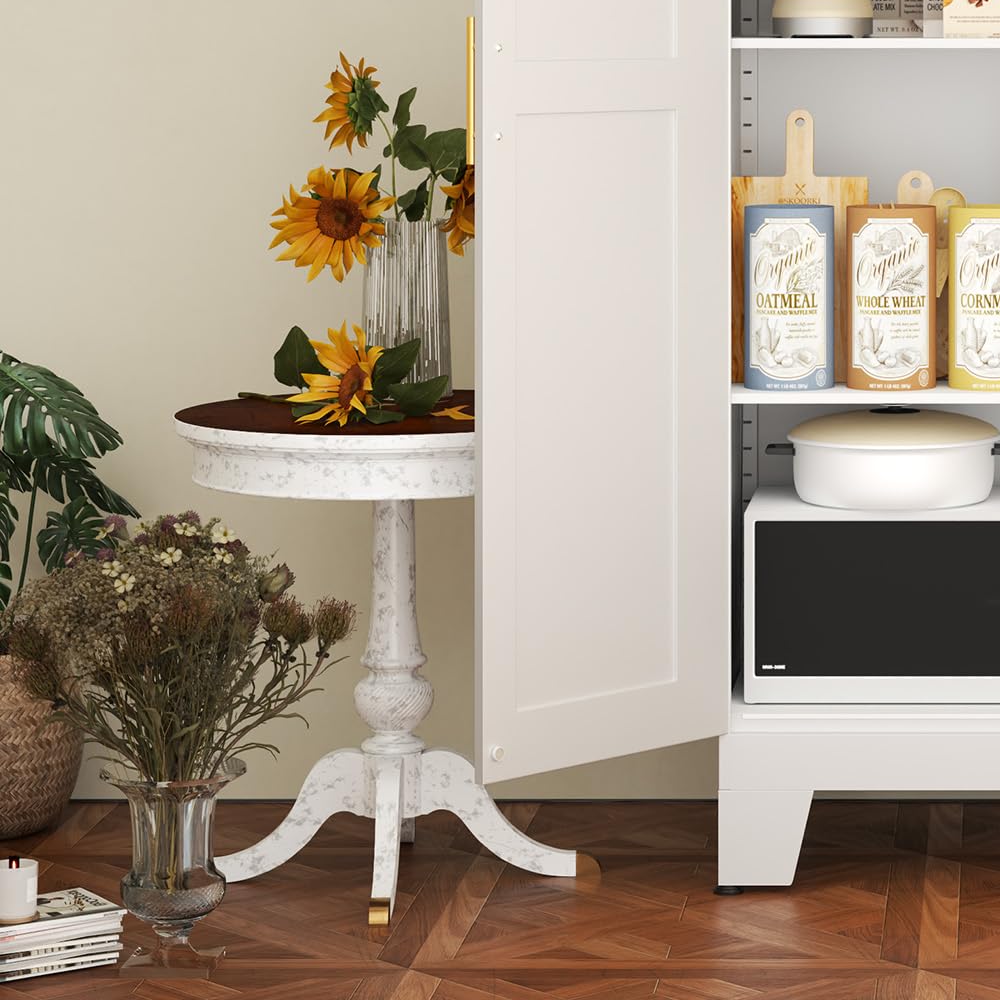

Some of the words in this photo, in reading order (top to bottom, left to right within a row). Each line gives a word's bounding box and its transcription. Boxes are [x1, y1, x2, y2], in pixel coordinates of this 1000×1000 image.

[754, 237, 816, 288] Organic
[857, 237, 919, 290] Organic
[756, 293, 818, 308] OATMEAL
[856, 296, 890, 308] WHOLE
[892, 296, 926, 308] WHEAT
